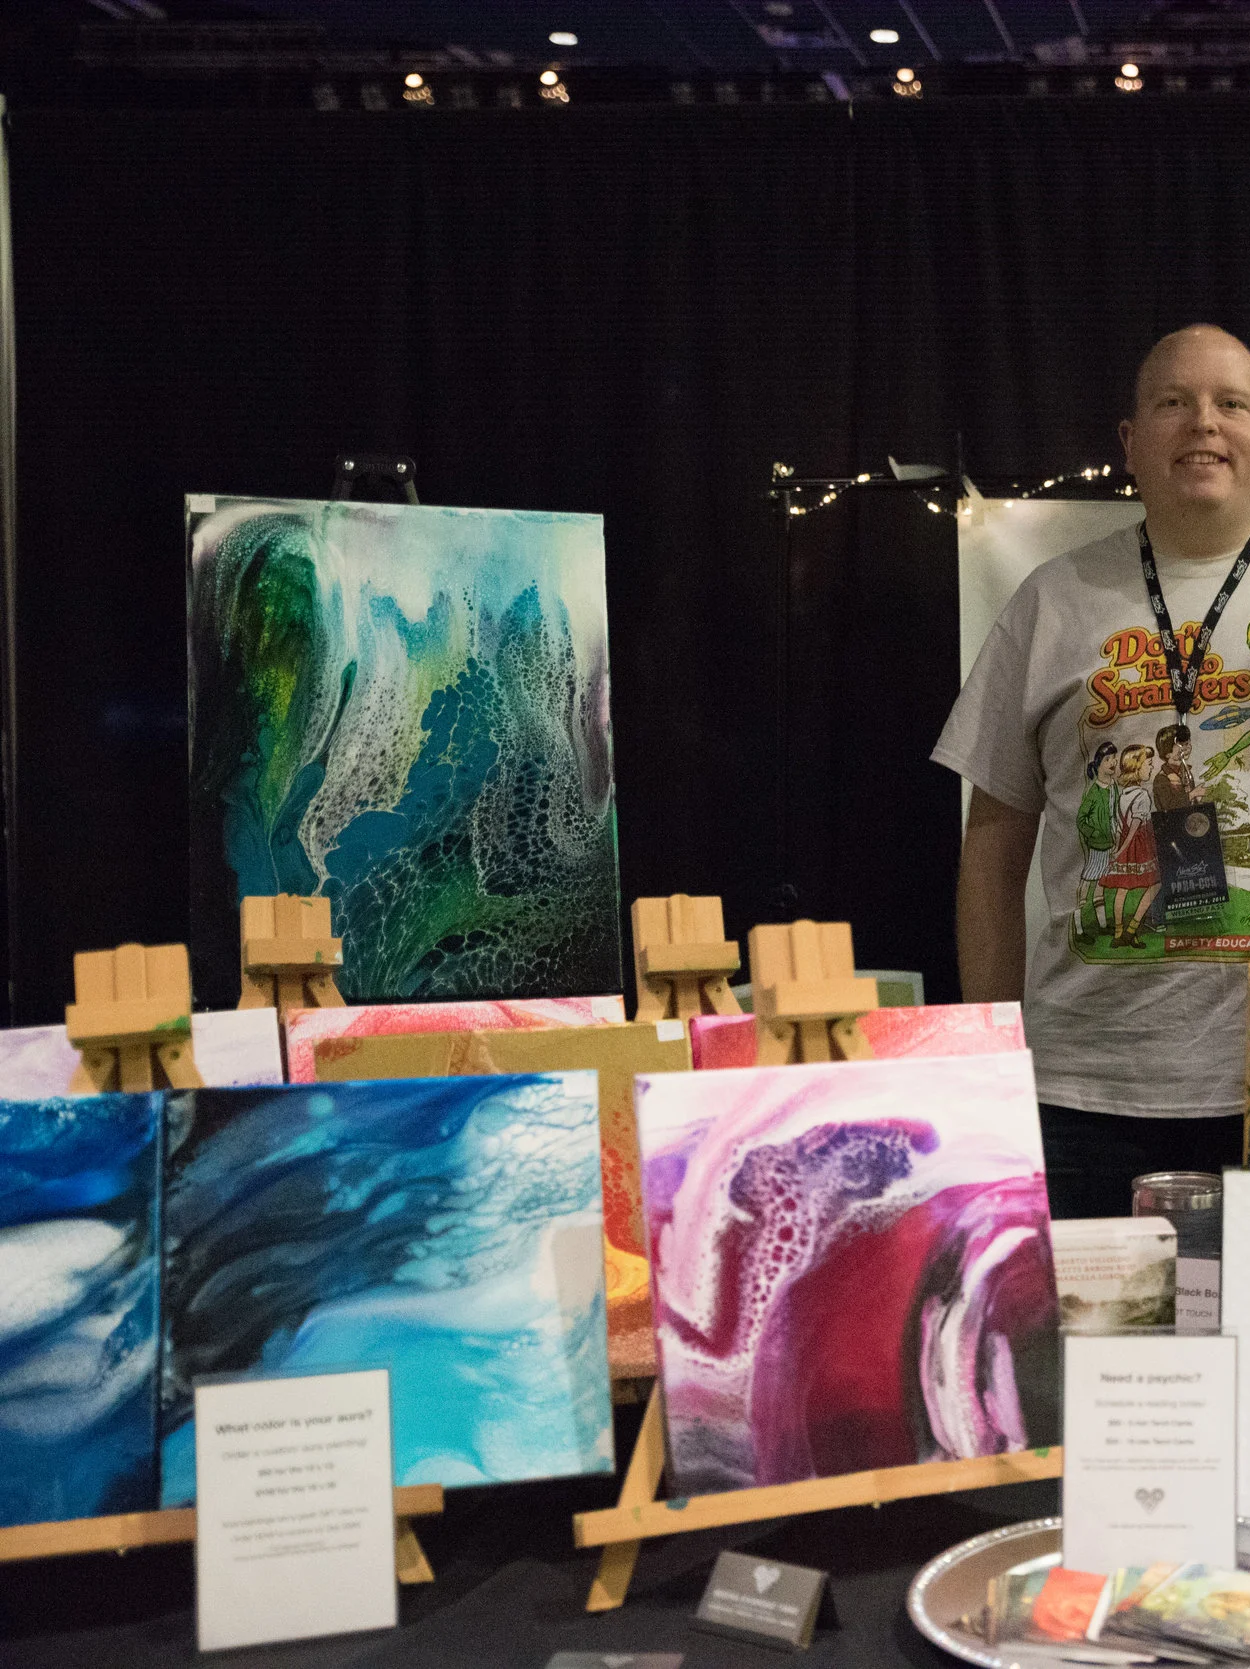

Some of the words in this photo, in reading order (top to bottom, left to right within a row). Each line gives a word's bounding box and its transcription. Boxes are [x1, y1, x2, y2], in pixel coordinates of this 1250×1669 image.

[1103, 624, 1206, 667] Don'
[1169, 938, 1213, 948] SAFETY
[1186, 1308, 1212, 1318] TOUCH
[1099, 1373, 1132, 1383] Need
[1147, 1373, 1202, 1385] psychic?
[215, 1423, 249, 1435] What
[253, 1420, 285, 1431] color
[290, 1418, 300, 1427] is
[304, 1416, 333, 1428] your
[337, 1408, 373, 1423] aura?
